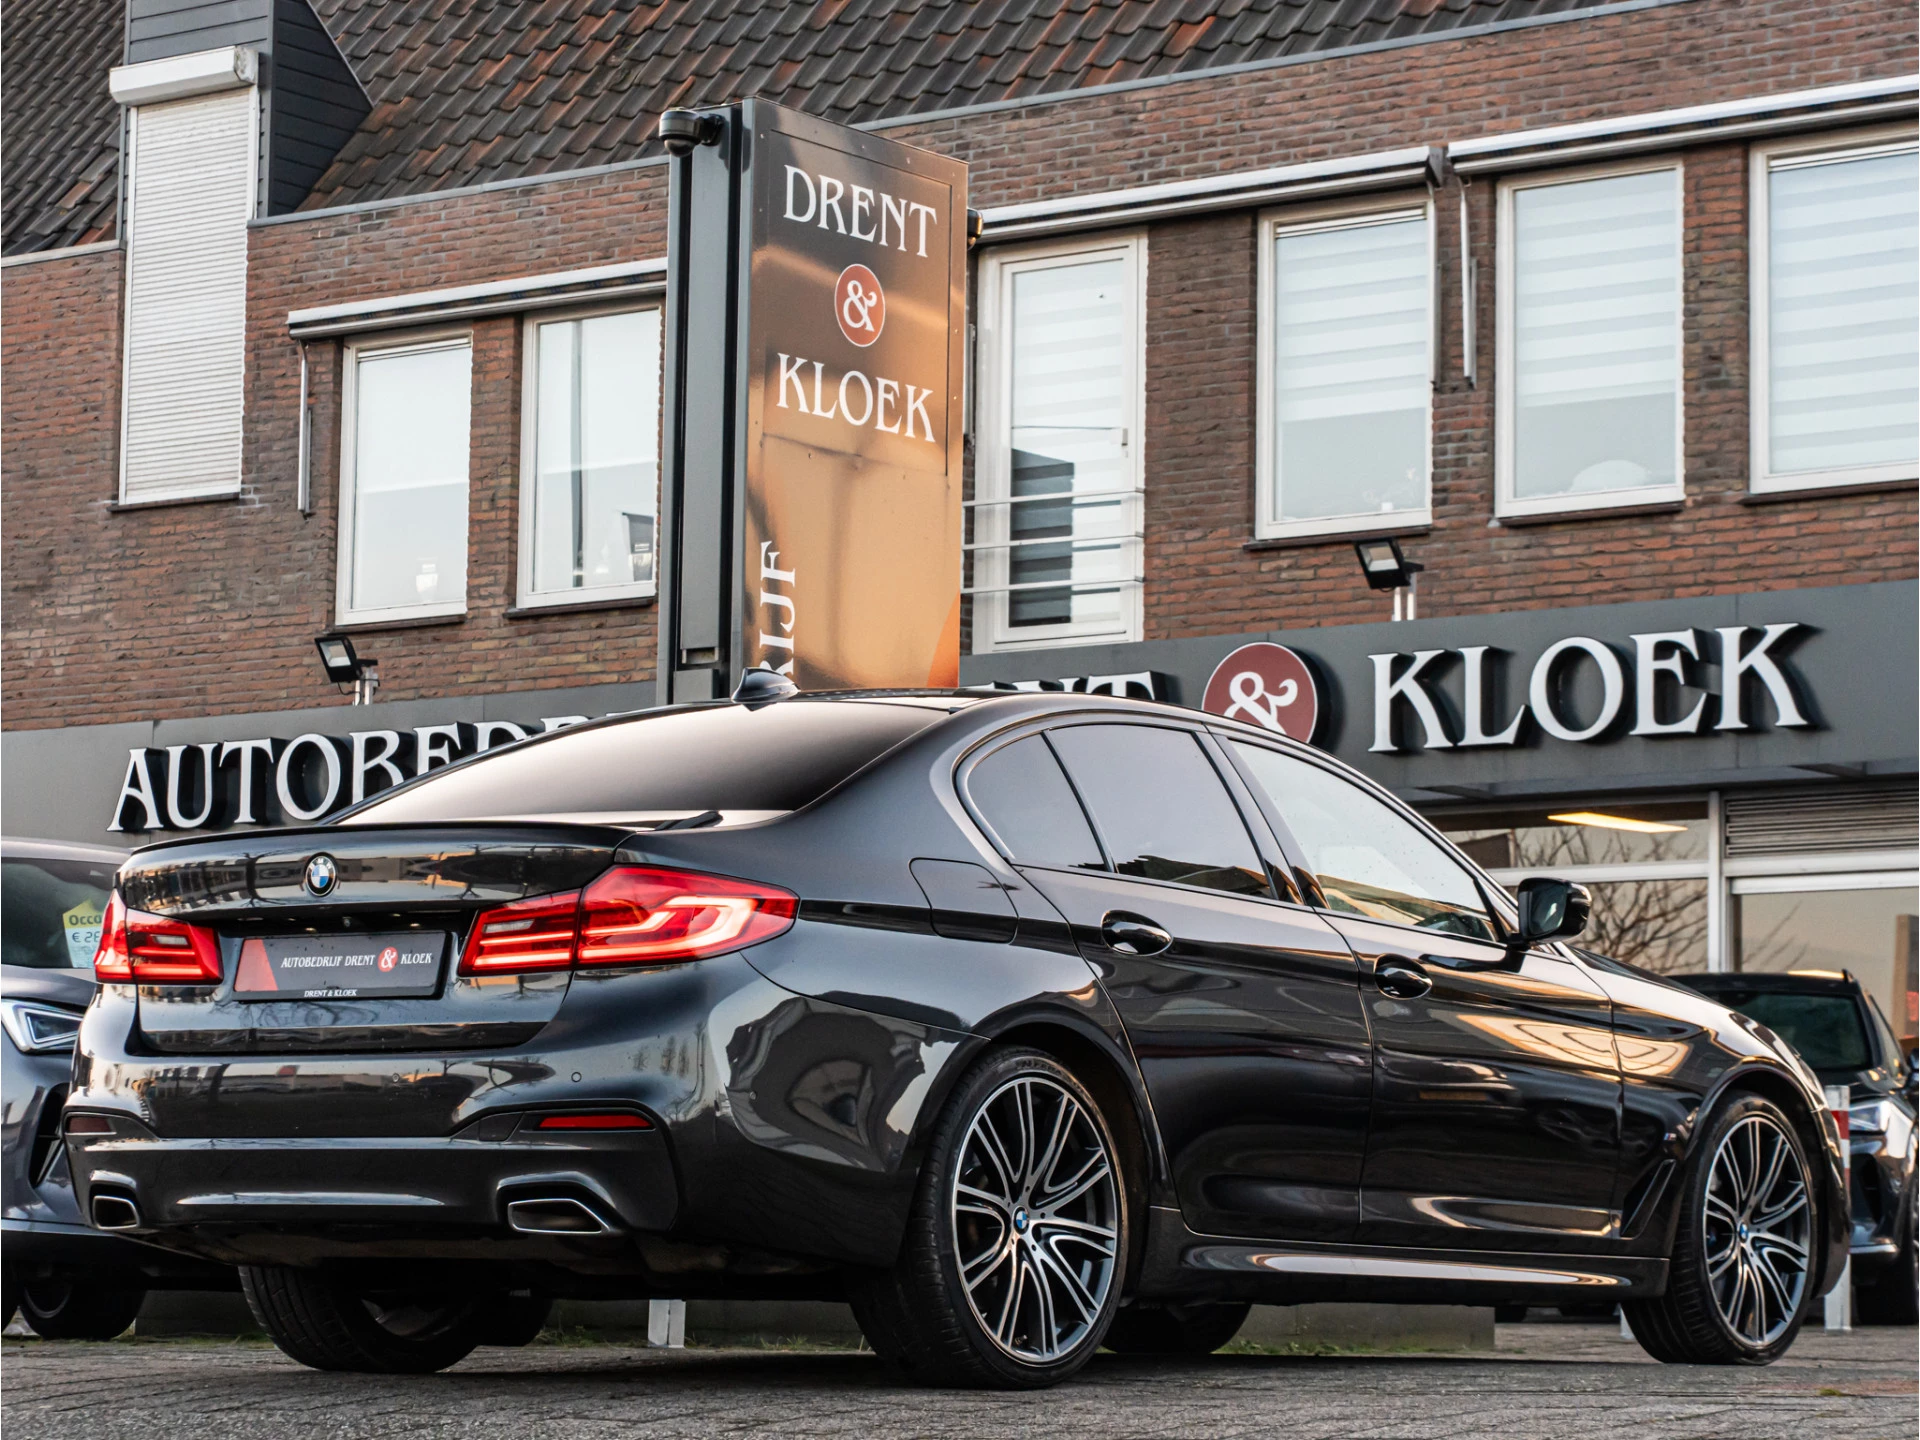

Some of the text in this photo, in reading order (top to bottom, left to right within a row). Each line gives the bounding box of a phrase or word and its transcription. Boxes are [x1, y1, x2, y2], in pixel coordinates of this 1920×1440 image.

[783, 165, 937, 258] DRENT
[842, 280, 877, 332] &
[776, 353, 936, 443] KLOEK
[1369, 622, 1812, 754] KLOEK
[281, 949, 433, 969] AUTOBEDRIJF DRENT & KLOEK
[303, 990, 327, 998] DRENT
[333, 988, 358, 997] KLOEK
